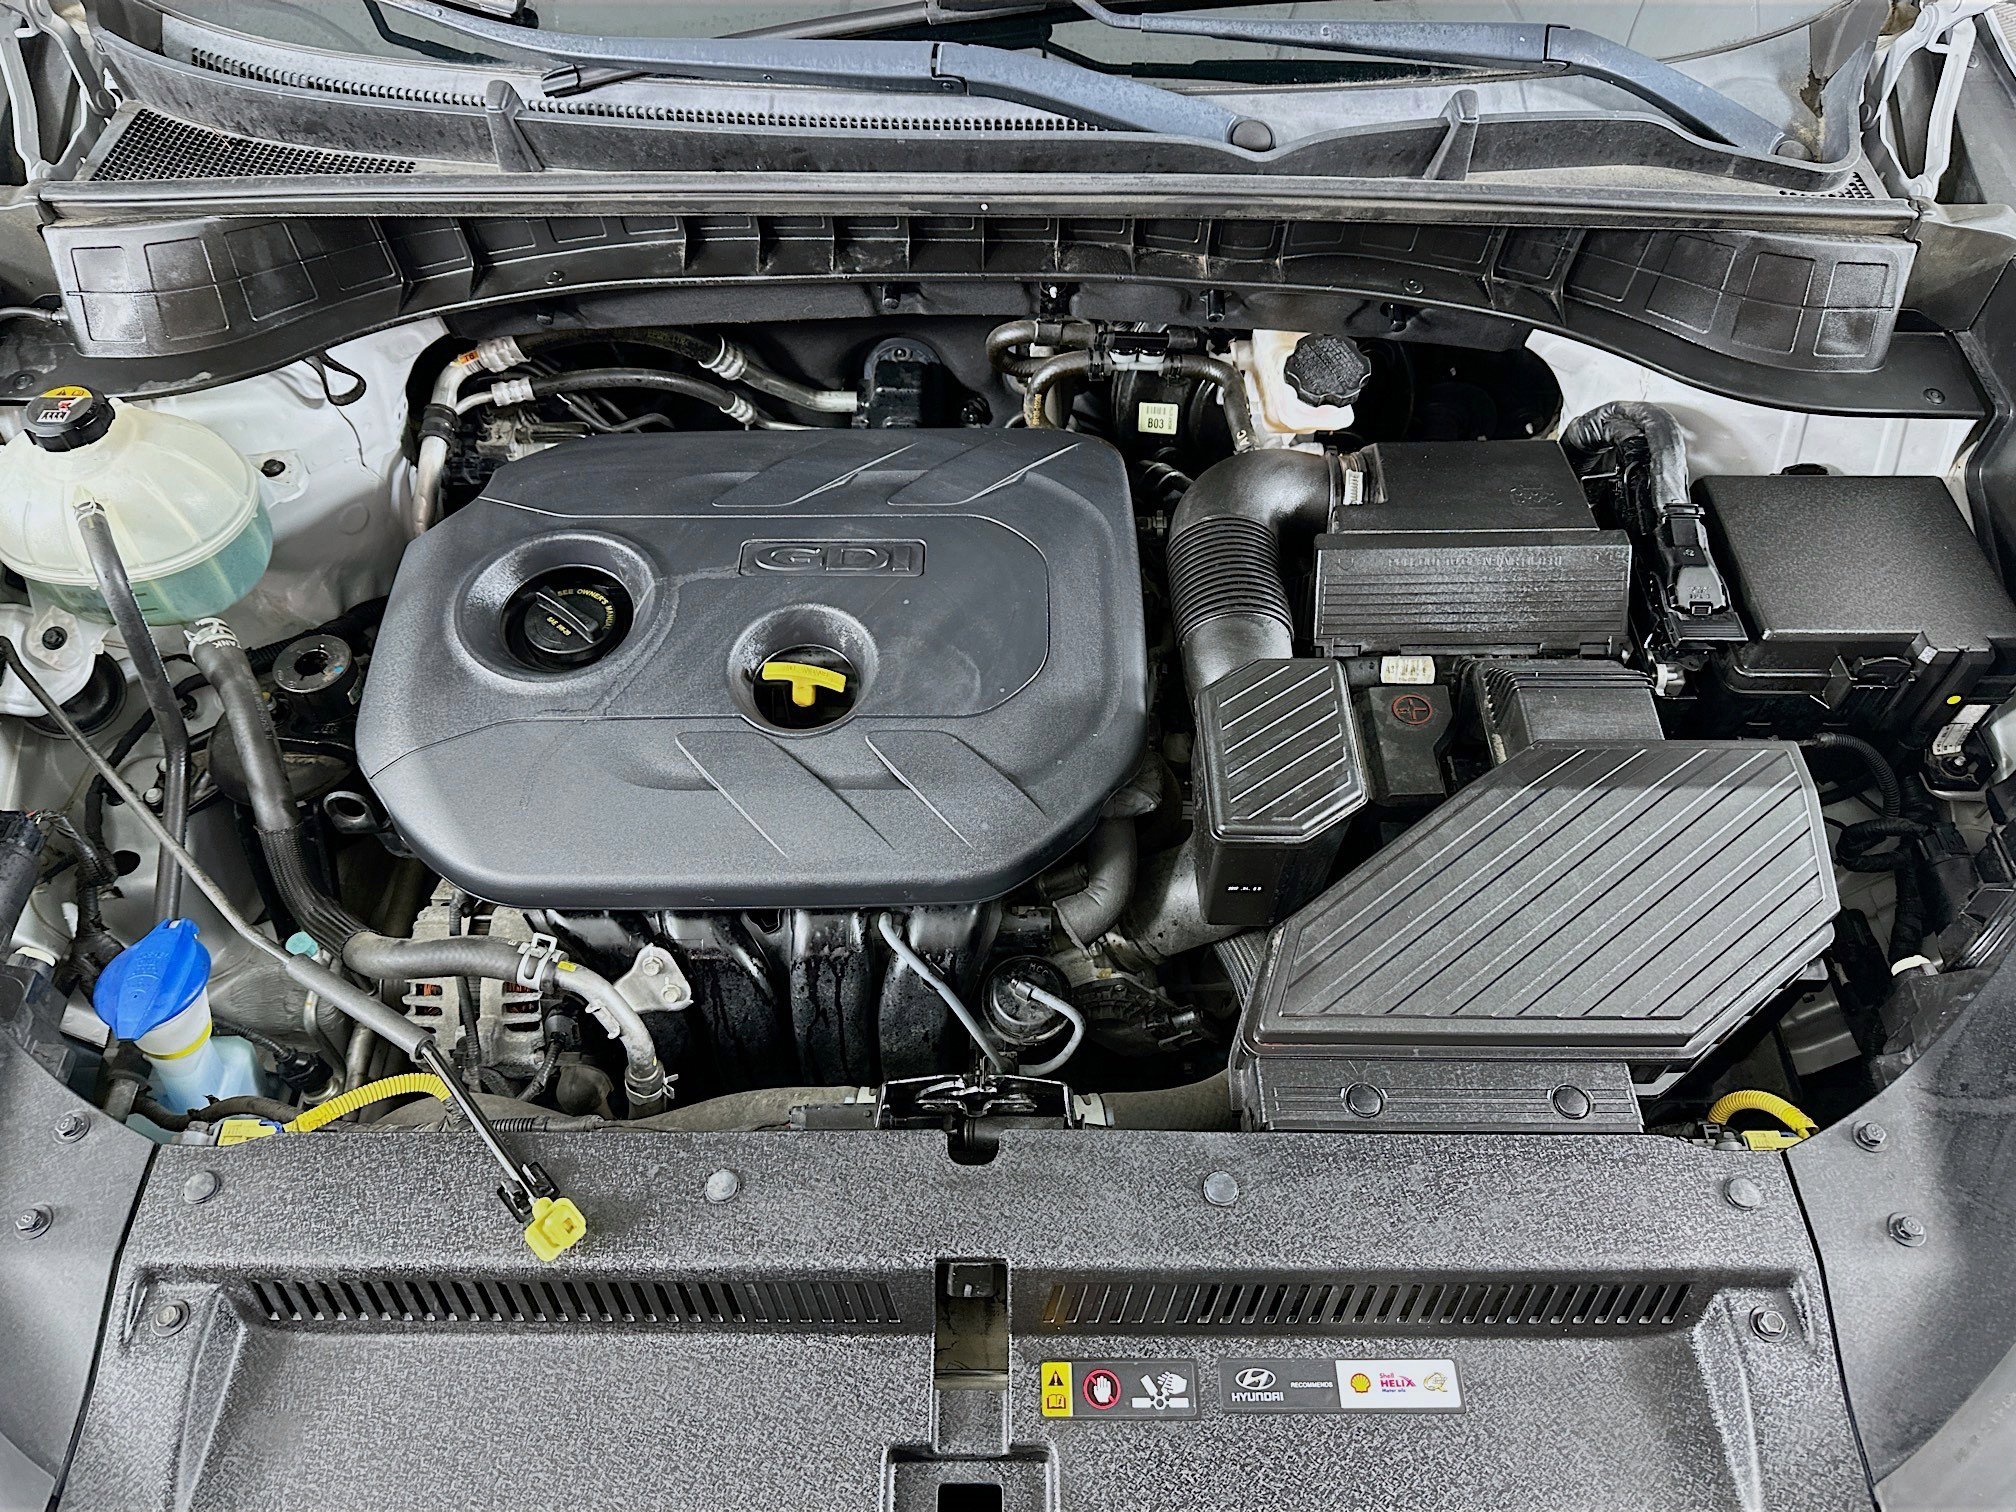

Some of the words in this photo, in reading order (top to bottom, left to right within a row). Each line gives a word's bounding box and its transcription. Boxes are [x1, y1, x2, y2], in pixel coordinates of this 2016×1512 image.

[1147, 417, 1164, 429] B03
[1236, 429, 1250, 446] AC
[754, 545, 911, 572] GDI
[557, 588, 574, 597] SEE
[576, 588, 609, 606] OWNER'S
[604, 605, 616, 630] MANUAL
[1380, 1376, 1416, 1388] HELIX
[1231, 1391, 1285, 1402] HYUNDAI
